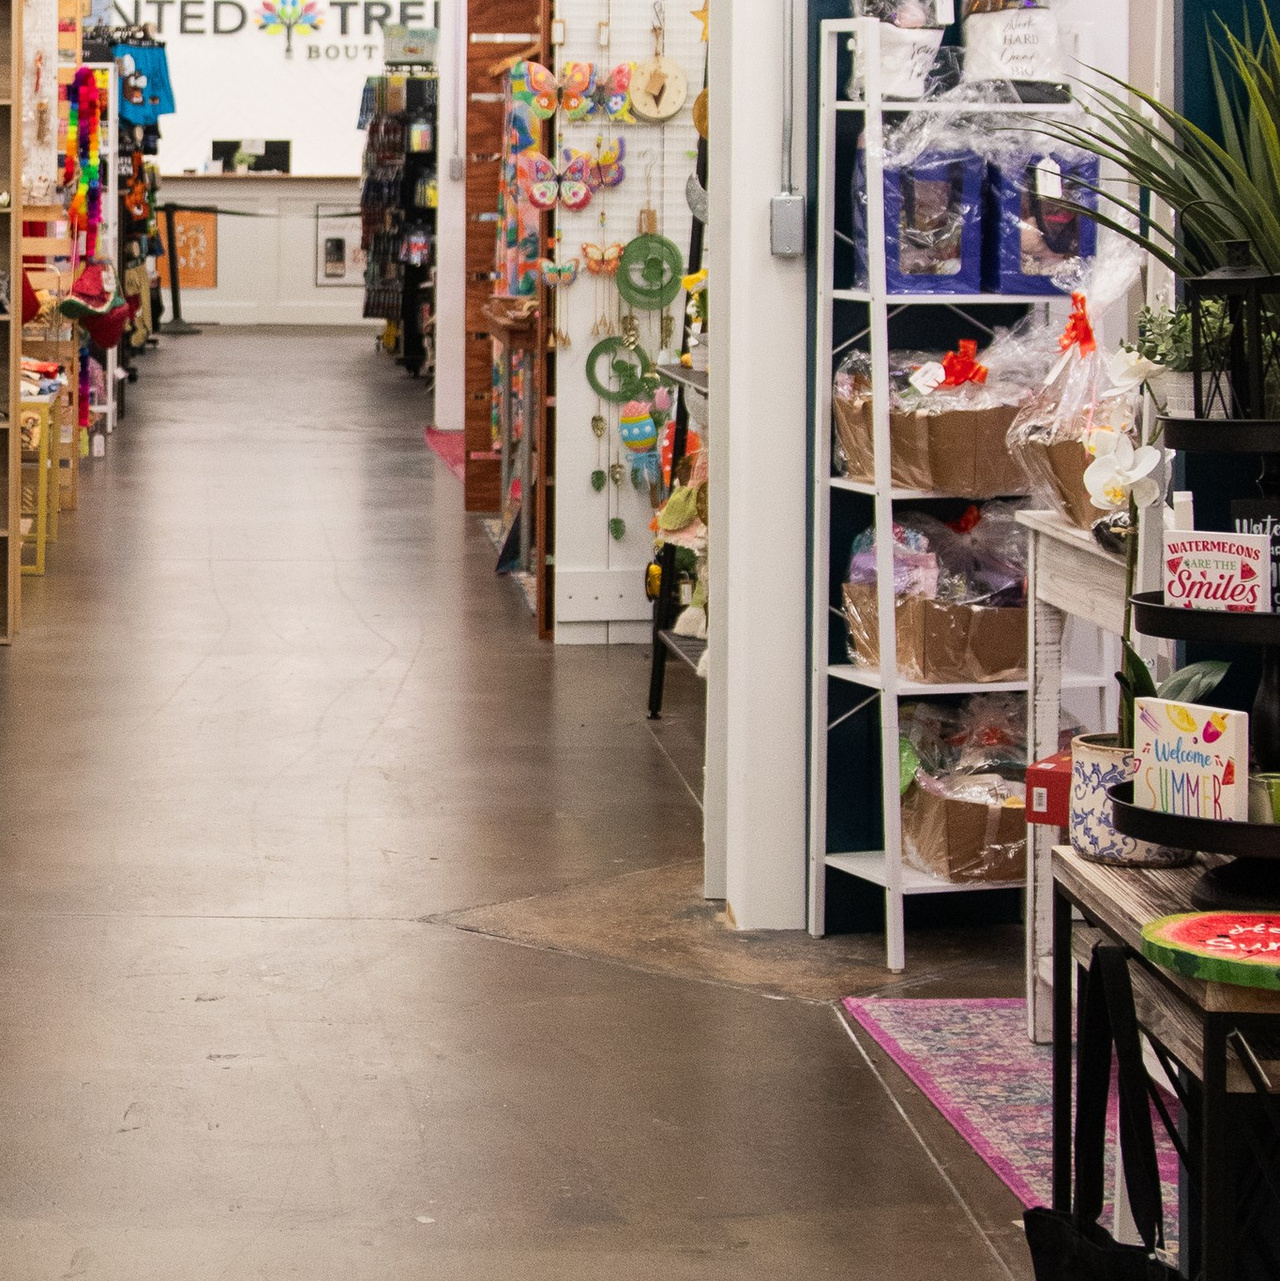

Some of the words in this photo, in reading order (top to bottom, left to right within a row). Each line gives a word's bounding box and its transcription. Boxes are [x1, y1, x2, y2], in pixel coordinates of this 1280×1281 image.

[1003, 33, 1039, 45] HARD
[1167, 540, 1261, 561] WATERMELONS
[1189, 559, 1212, 569] ARE
[1214, 559, 1237, 570] THE
[1167, 569, 1261, 604] Smiles
[1154, 736, 1212, 767] Welcome
[1145, 766, 1223, 821] SUMMER
